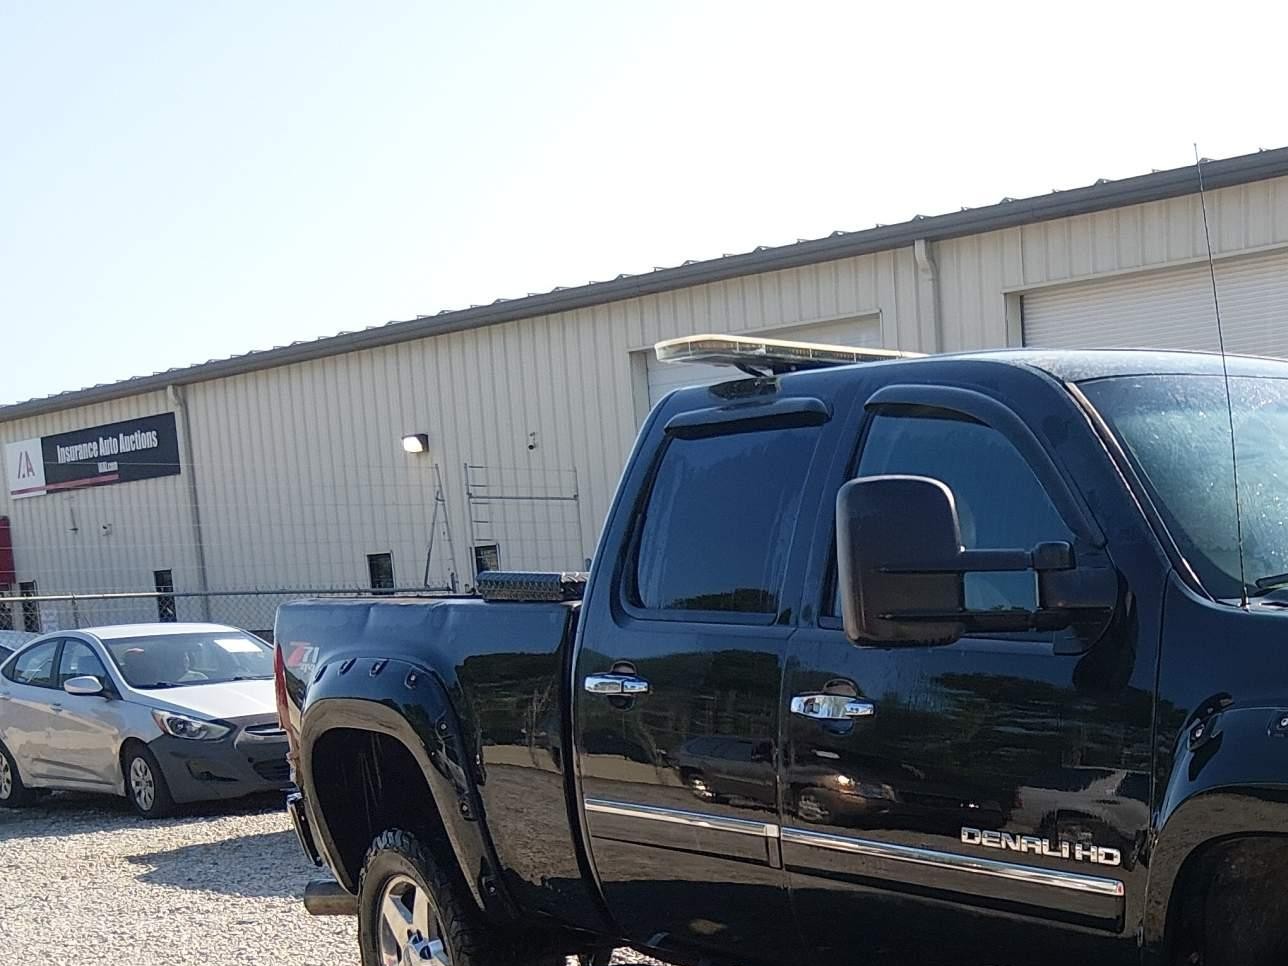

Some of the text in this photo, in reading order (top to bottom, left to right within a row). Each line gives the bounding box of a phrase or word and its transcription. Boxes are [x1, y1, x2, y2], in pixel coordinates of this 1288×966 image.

[57, 429, 159, 464] Insurance Auto Auctions
[960, 826, 1121, 866] DENALI HD
